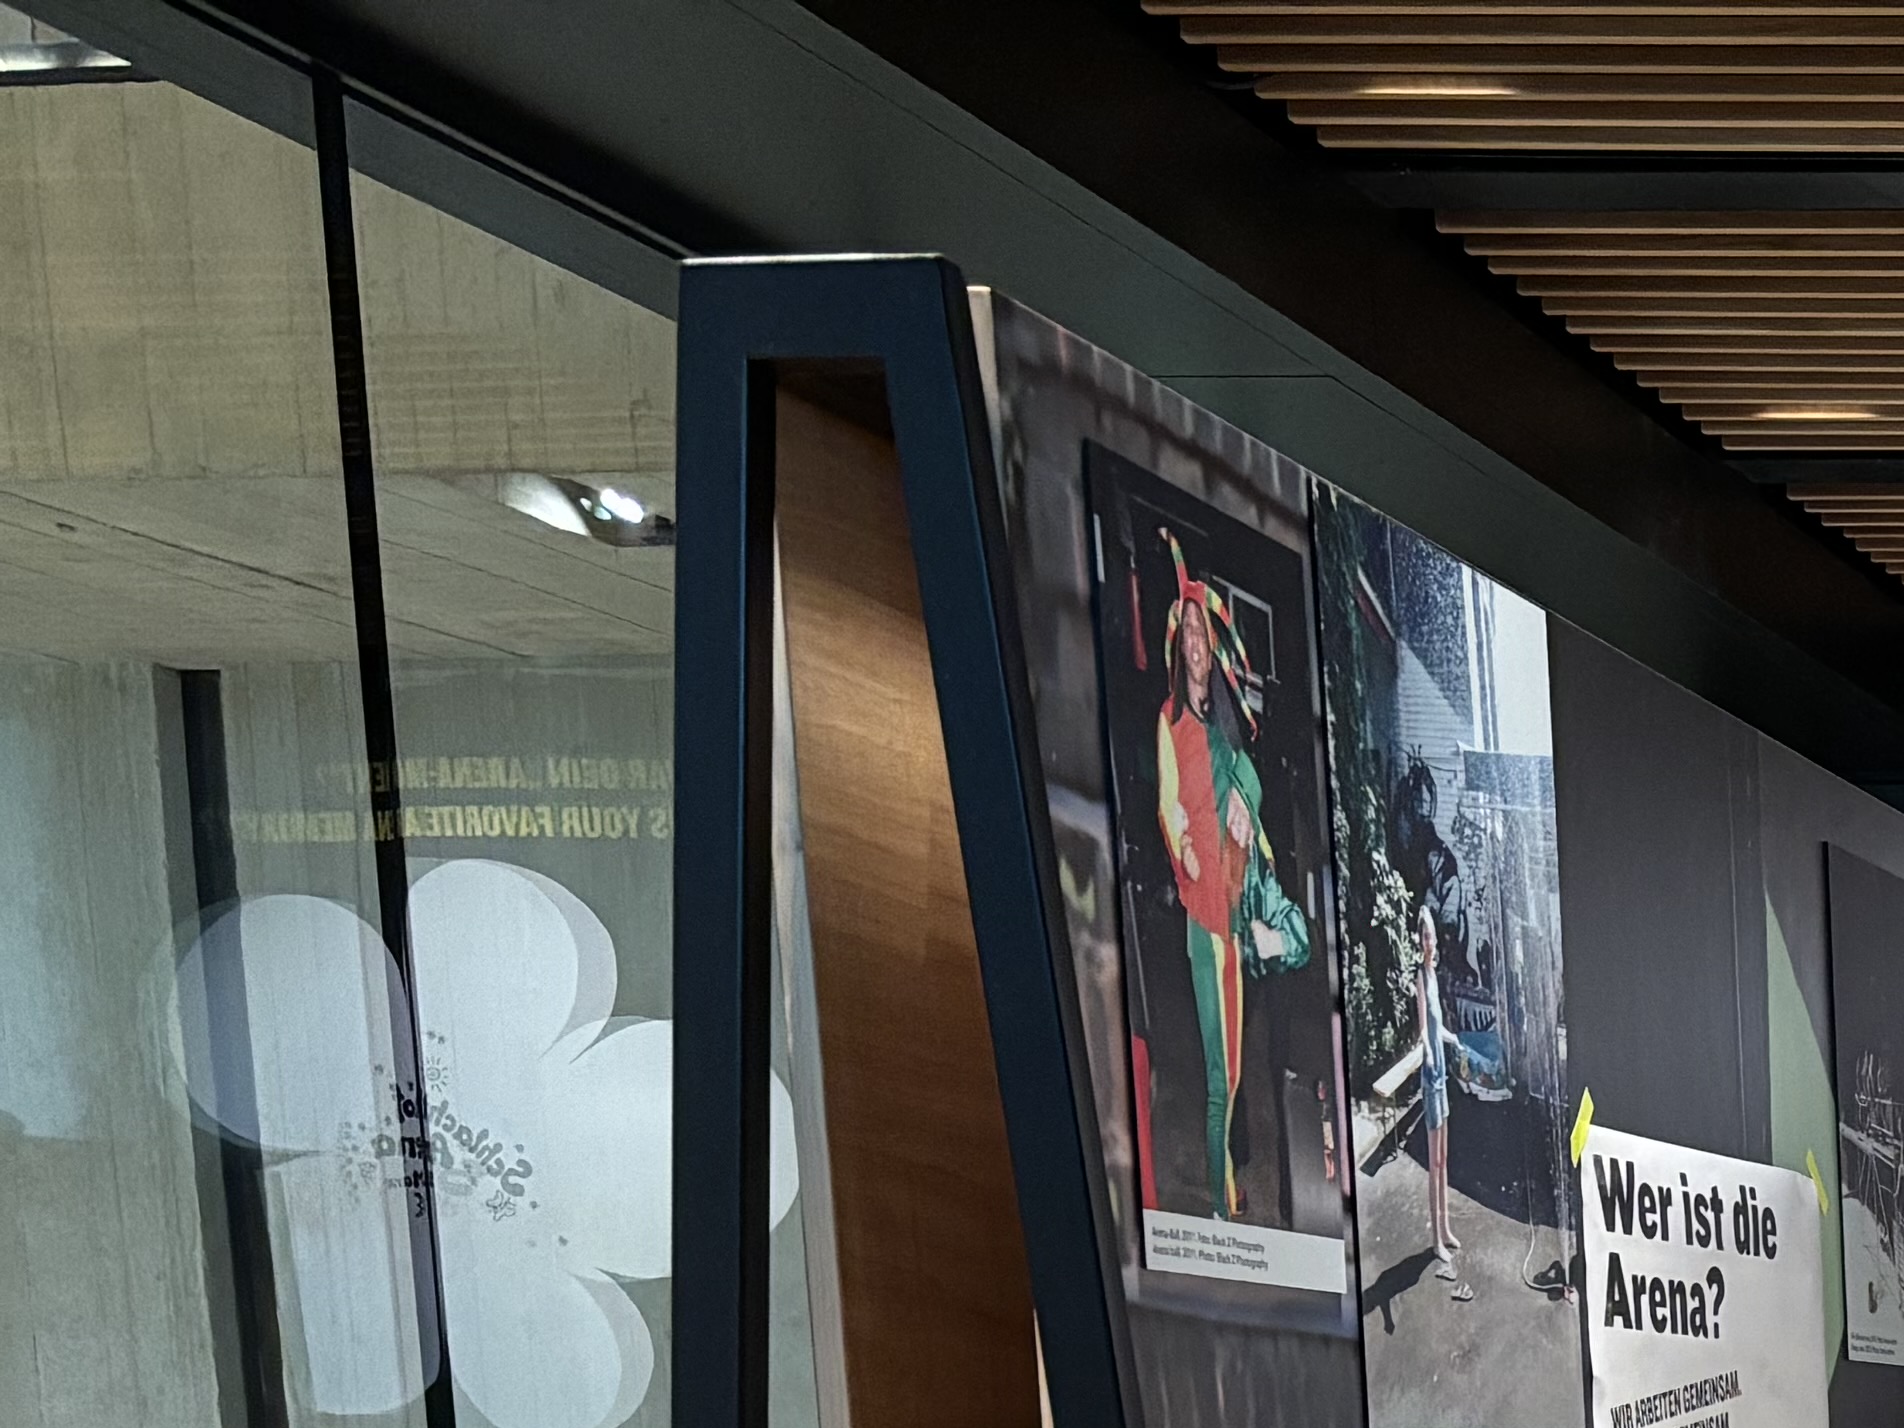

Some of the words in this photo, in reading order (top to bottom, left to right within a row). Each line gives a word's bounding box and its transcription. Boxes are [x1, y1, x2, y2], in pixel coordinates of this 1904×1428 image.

[1592, 1154, 1672, 1242] Wer
[1679, 1172, 1724, 1251] ist
[1733, 1184, 1777, 1260] die
[1604, 1252, 1725, 1339] Arena?
[1682, 1370, 1742, 1414] GEMEINSAM.
